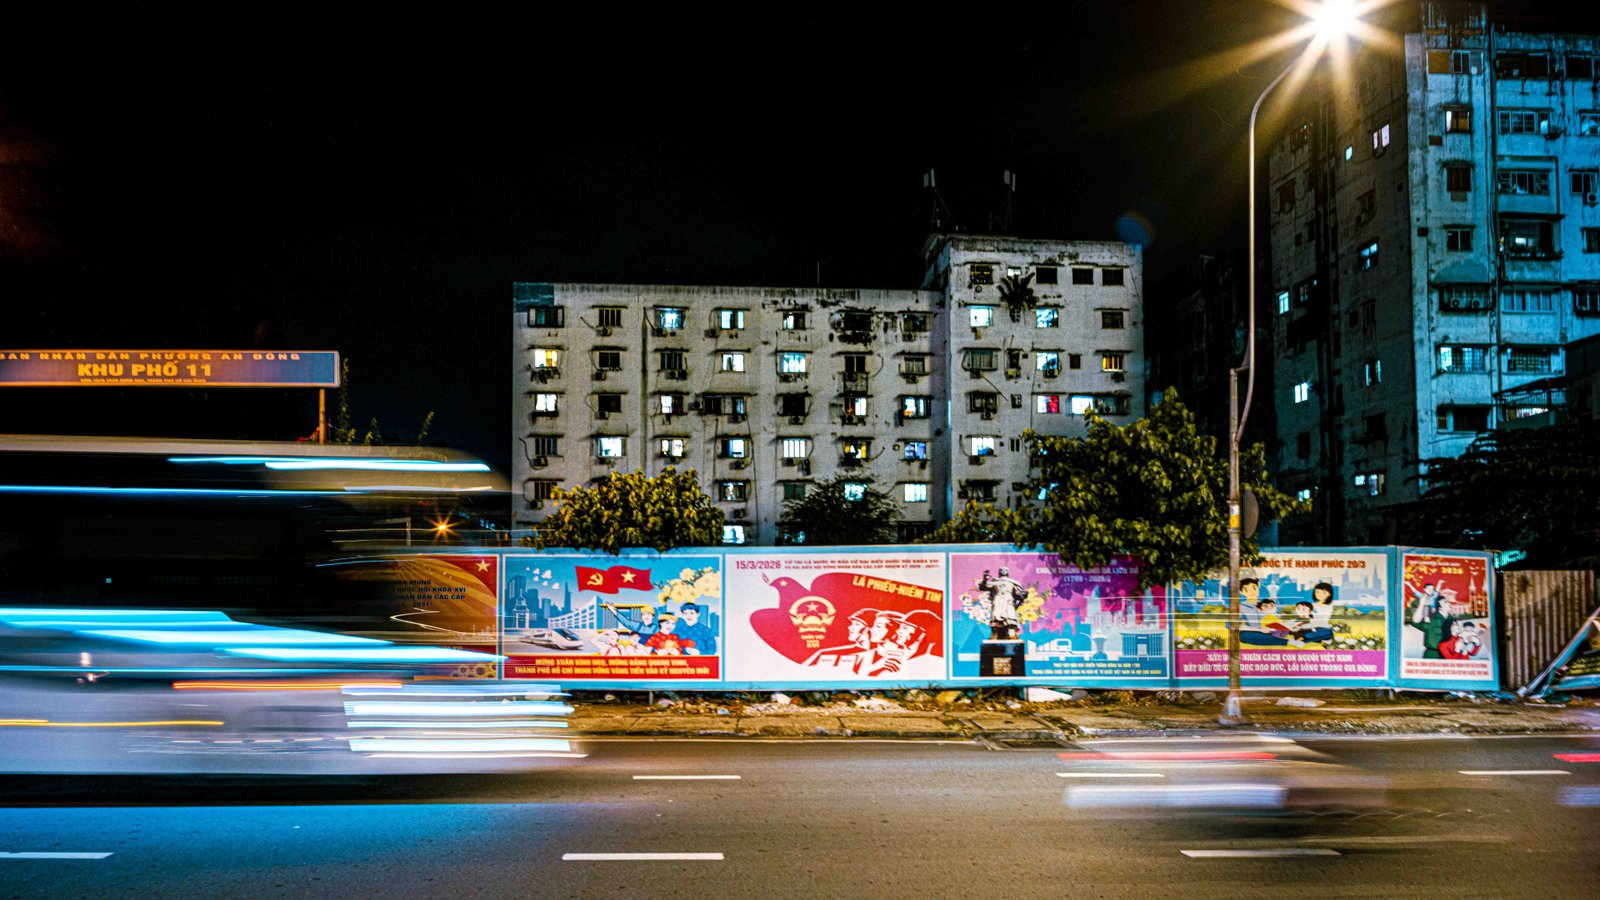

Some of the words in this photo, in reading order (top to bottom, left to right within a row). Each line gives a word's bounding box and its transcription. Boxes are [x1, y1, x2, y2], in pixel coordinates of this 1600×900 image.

[78, 363, 123, 376] KHU
[131, 360, 179, 376] PHỐ
[186, 364, 211, 376] 11
[736, 561, 781, 569] 15/3/2026
[1283, 558, 1293, 568] TẾ
[1295, 559, 1319, 569] HẠNH
[1321, 558, 1345, 568] PHÚC
[1346, 560, 1366, 568] 20/3
[852, 575, 866, 587] LÁ
[925, 590, 942, 603] TIN
[1242, 653, 1261, 661] NHÂN
[1262, 653, 1280, 661] CÁCH
[1282, 653, 1296, 661] CON
[1298, 653, 1319, 661] NGƯỜI
[1320, 653, 1336, 661] VIỆT
[1337, 653, 1353, 661] NAM
[1320, 663, 1343, 672] TRONG
[1344, 663, 1356, 672] GIA
